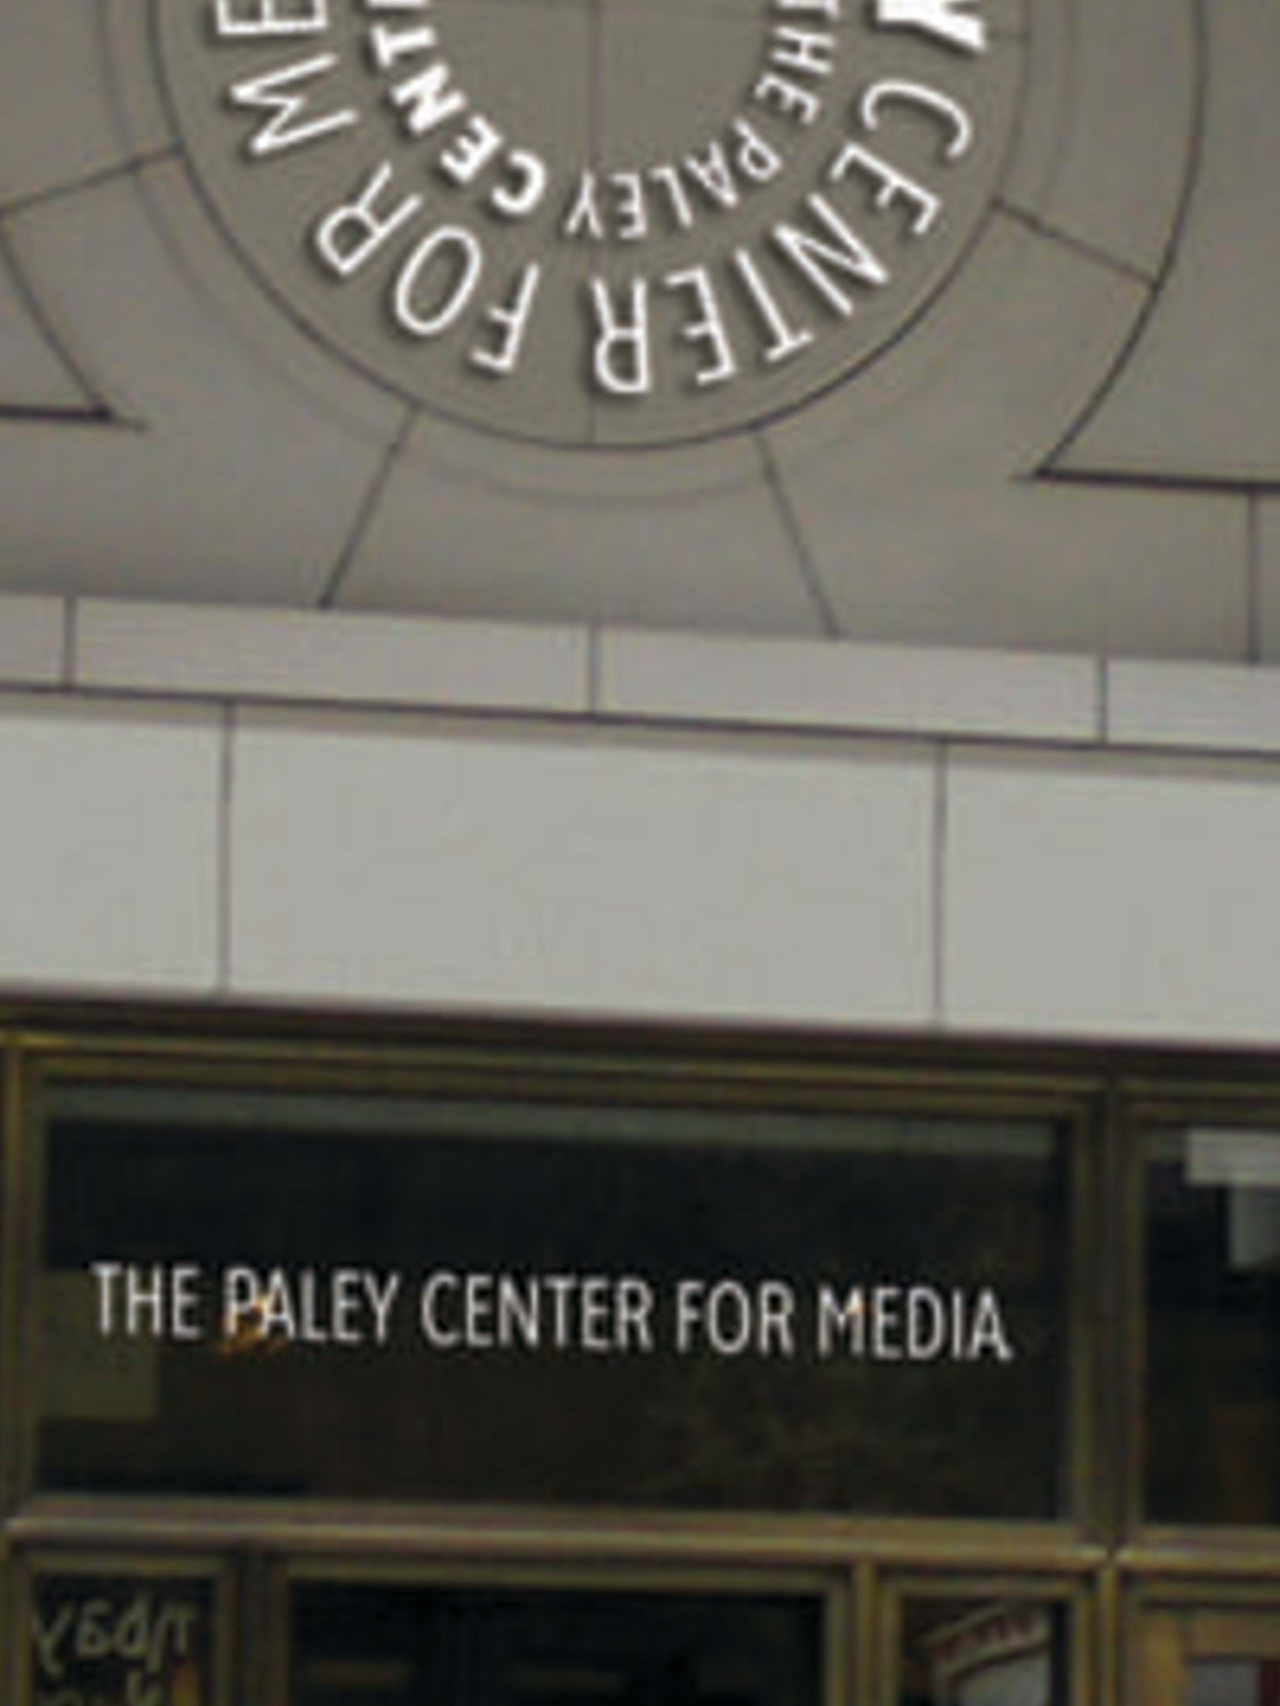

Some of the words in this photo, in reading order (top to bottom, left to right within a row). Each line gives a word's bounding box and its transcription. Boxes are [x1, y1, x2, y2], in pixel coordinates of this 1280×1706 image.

[564, 119, 783, 241] PALEY
[594, 77, 972, 393] CENTER
[316, 164, 538, 373] FOR
[92, 1263, 200, 1339] THE
[223, 1266, 400, 1345] PALEY
[420, 1271, 654, 1349] CENTER
[676, 1279, 794, 1355] FOR
[816, 1285, 1014, 1363] MEDIA
